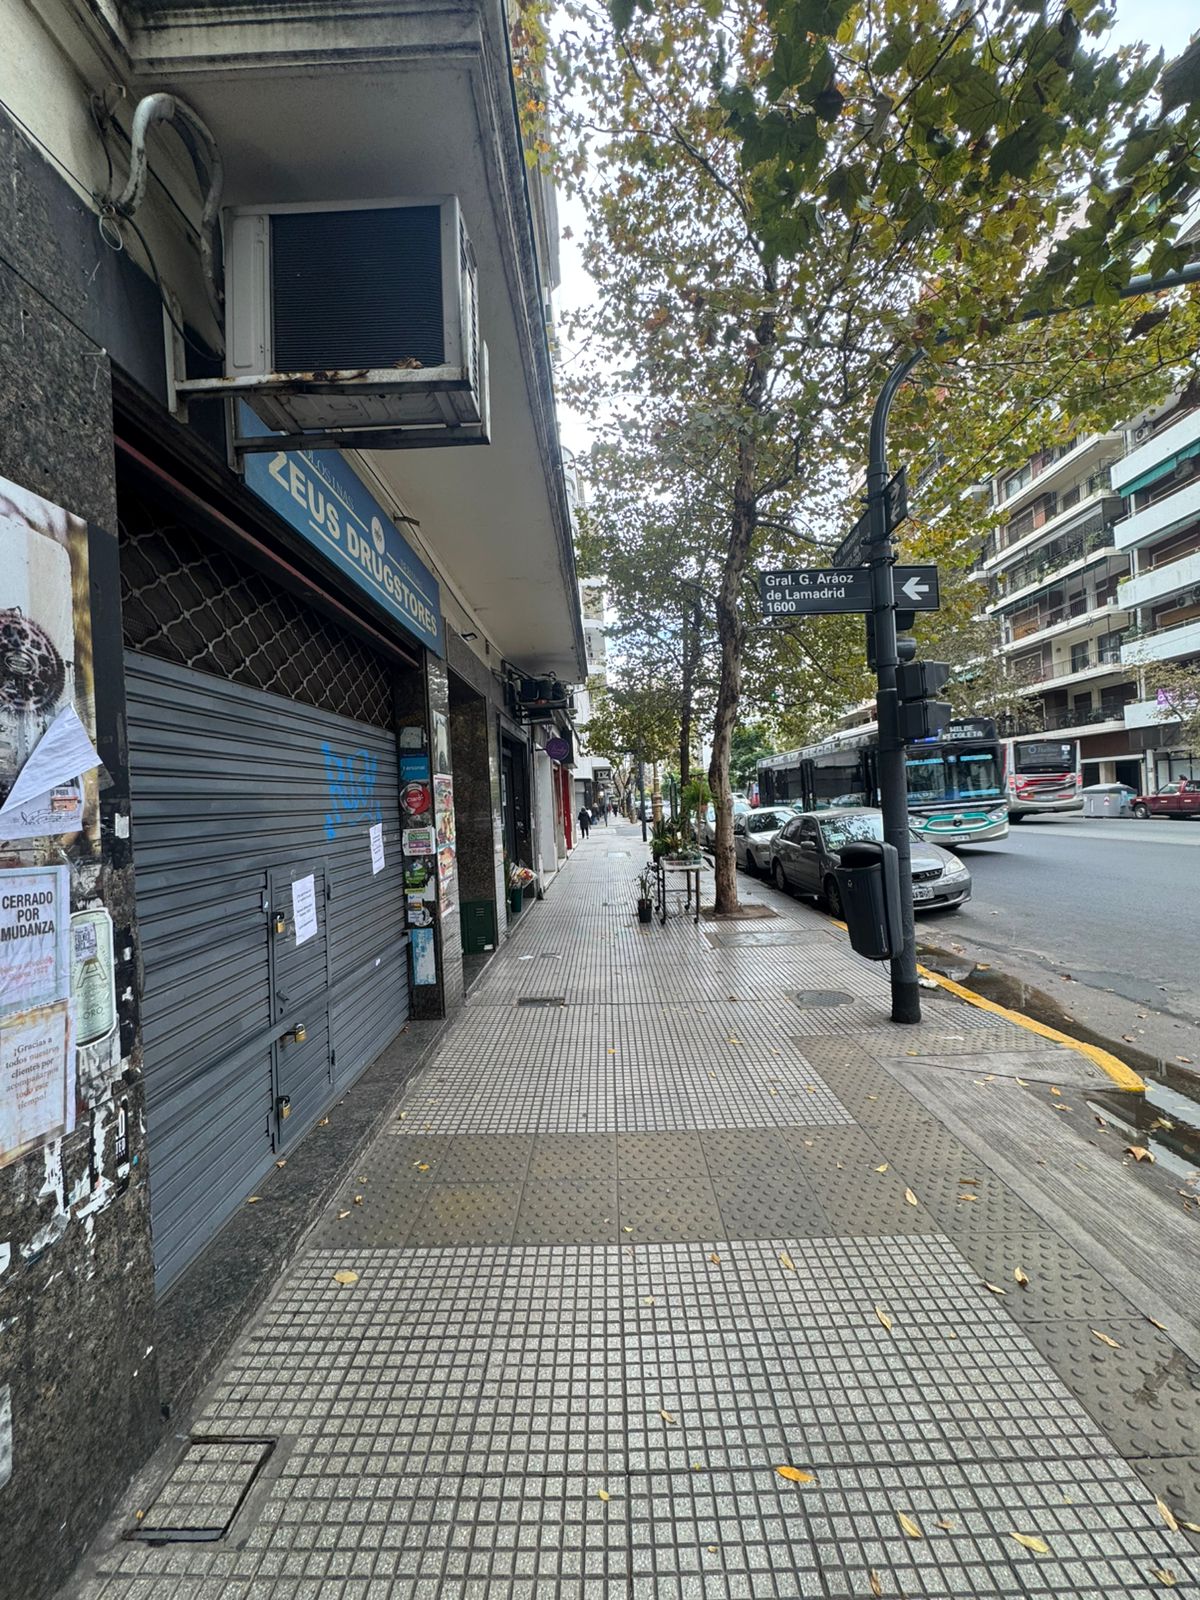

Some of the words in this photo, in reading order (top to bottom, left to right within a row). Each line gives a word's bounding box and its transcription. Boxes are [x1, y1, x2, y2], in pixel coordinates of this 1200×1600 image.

[268, 451, 341, 540] ZEUS
[346, 522, 438, 638] DRUGSTORES
[765, 574, 796, 587] Gral.
[798, 573, 813, 585] G.
[816, 572, 854, 585] Aráoz
[766, 589, 783, 601] de
[785, 587, 846, 600] Lamadrid
[766, 601, 796, 613] 1600
[2, 891, 53, 910] CERRADO
[17, 907, 40, 923] POR
[0, 920, 55, 942] MUDANZA
[14, 1038, 46, 1057] ¡Gracias
[5, 1056, 27, 1069] todos
[11, 1063, 40, 1079] clientes
[41, 1057, 54, 1070] por
[16, 1088, 33, 1100] todo
